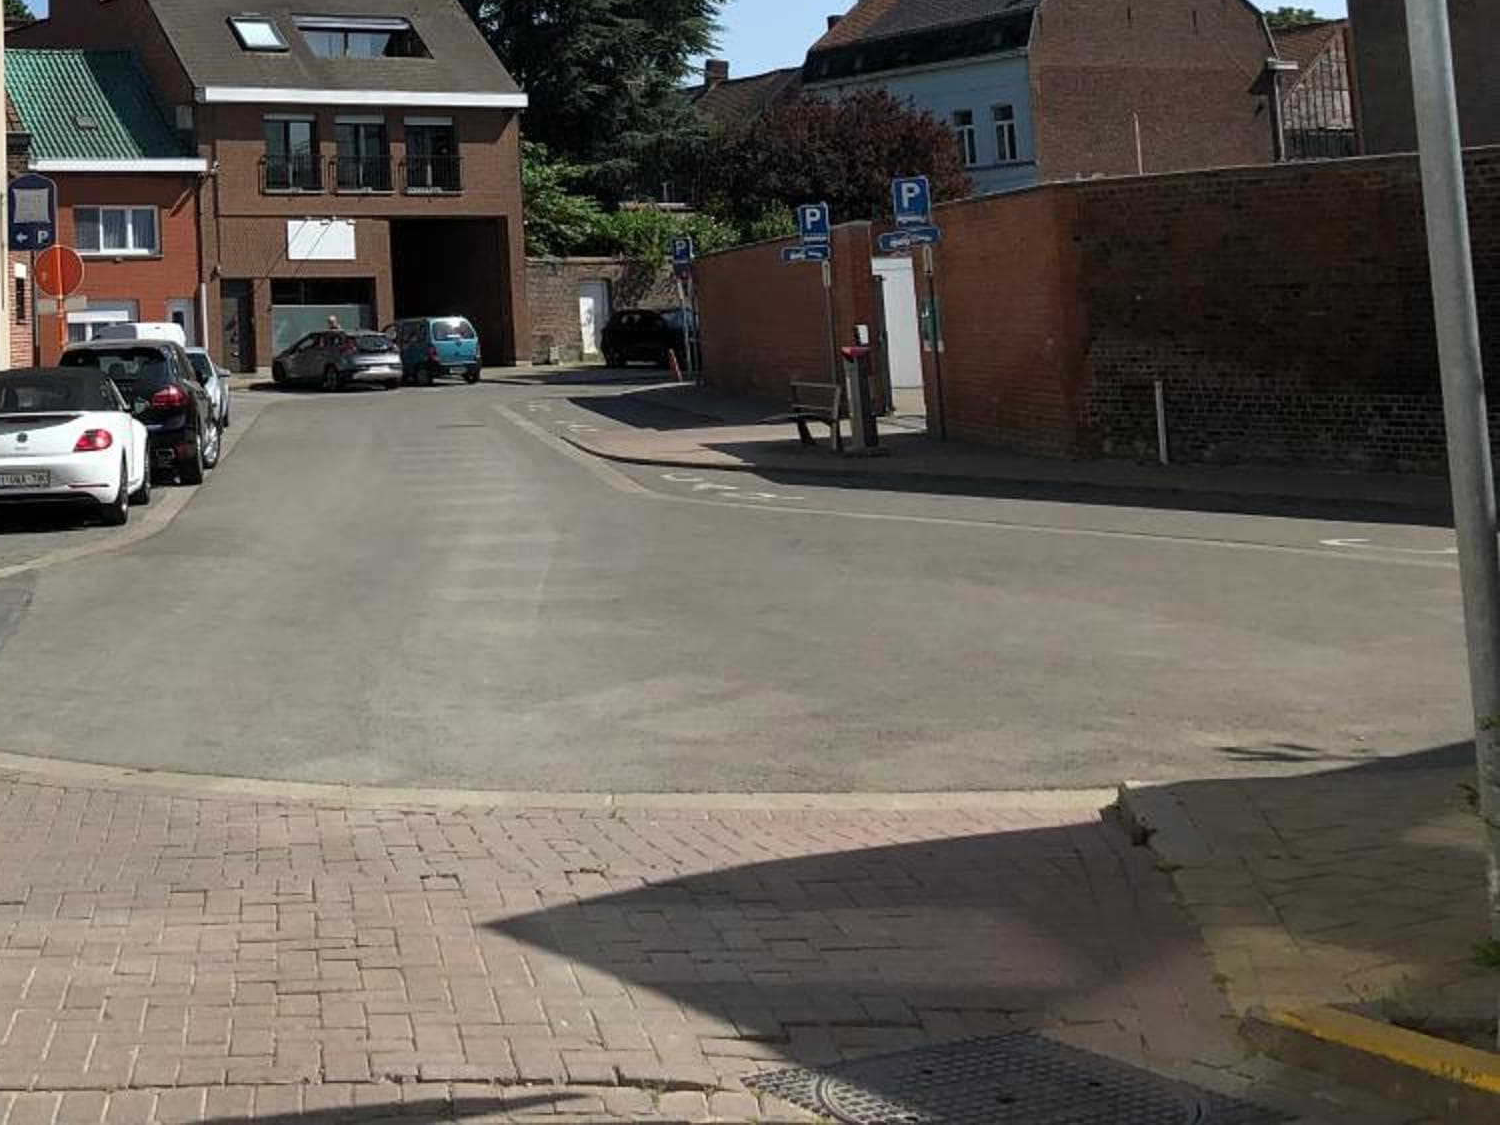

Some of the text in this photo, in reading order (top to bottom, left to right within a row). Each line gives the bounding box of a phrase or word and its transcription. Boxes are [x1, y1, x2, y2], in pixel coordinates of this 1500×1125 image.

[901, 182, 920, 209] P
[805, 208, 821, 229] P
[37, 230, 49, 244] P
